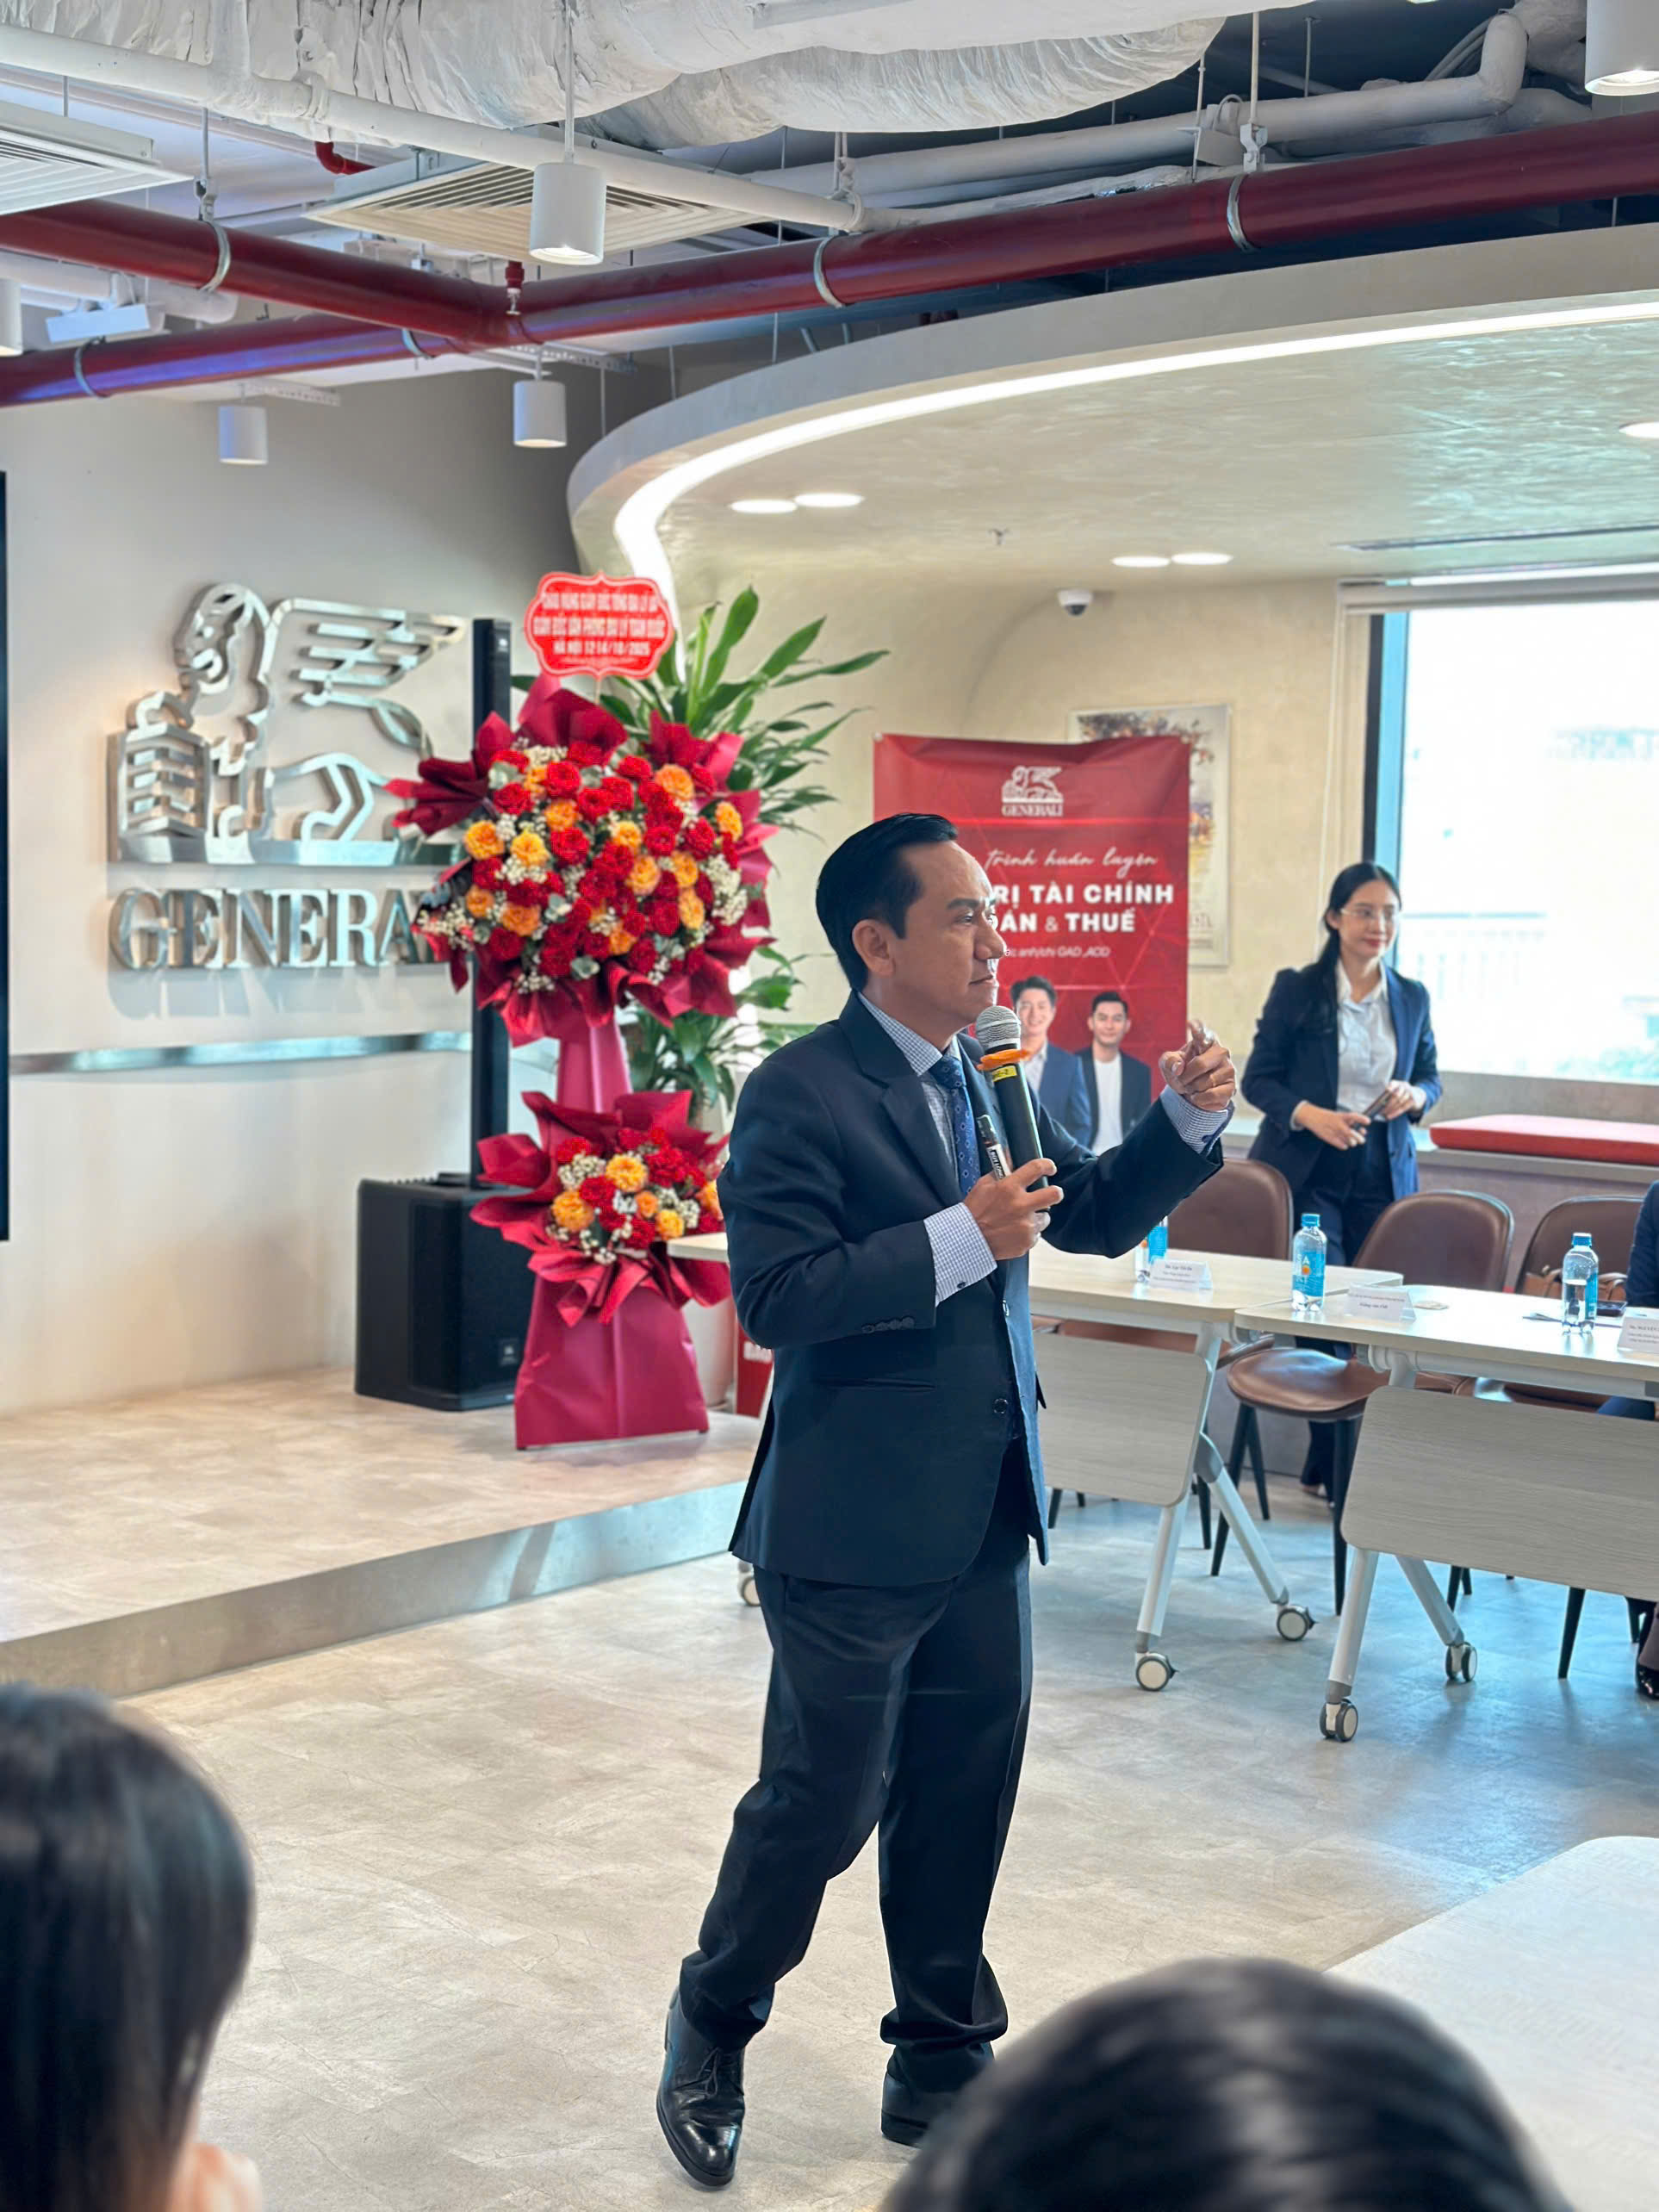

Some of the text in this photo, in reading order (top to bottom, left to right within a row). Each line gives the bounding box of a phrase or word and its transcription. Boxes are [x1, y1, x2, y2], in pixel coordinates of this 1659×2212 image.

[992, 880, 1174, 910] RỊ TÀI CHÍNH
[109, 887, 434, 970] GENERA
[1044, 916, 1059, 933] &
[1065, 907, 1136, 933] THUẾ
